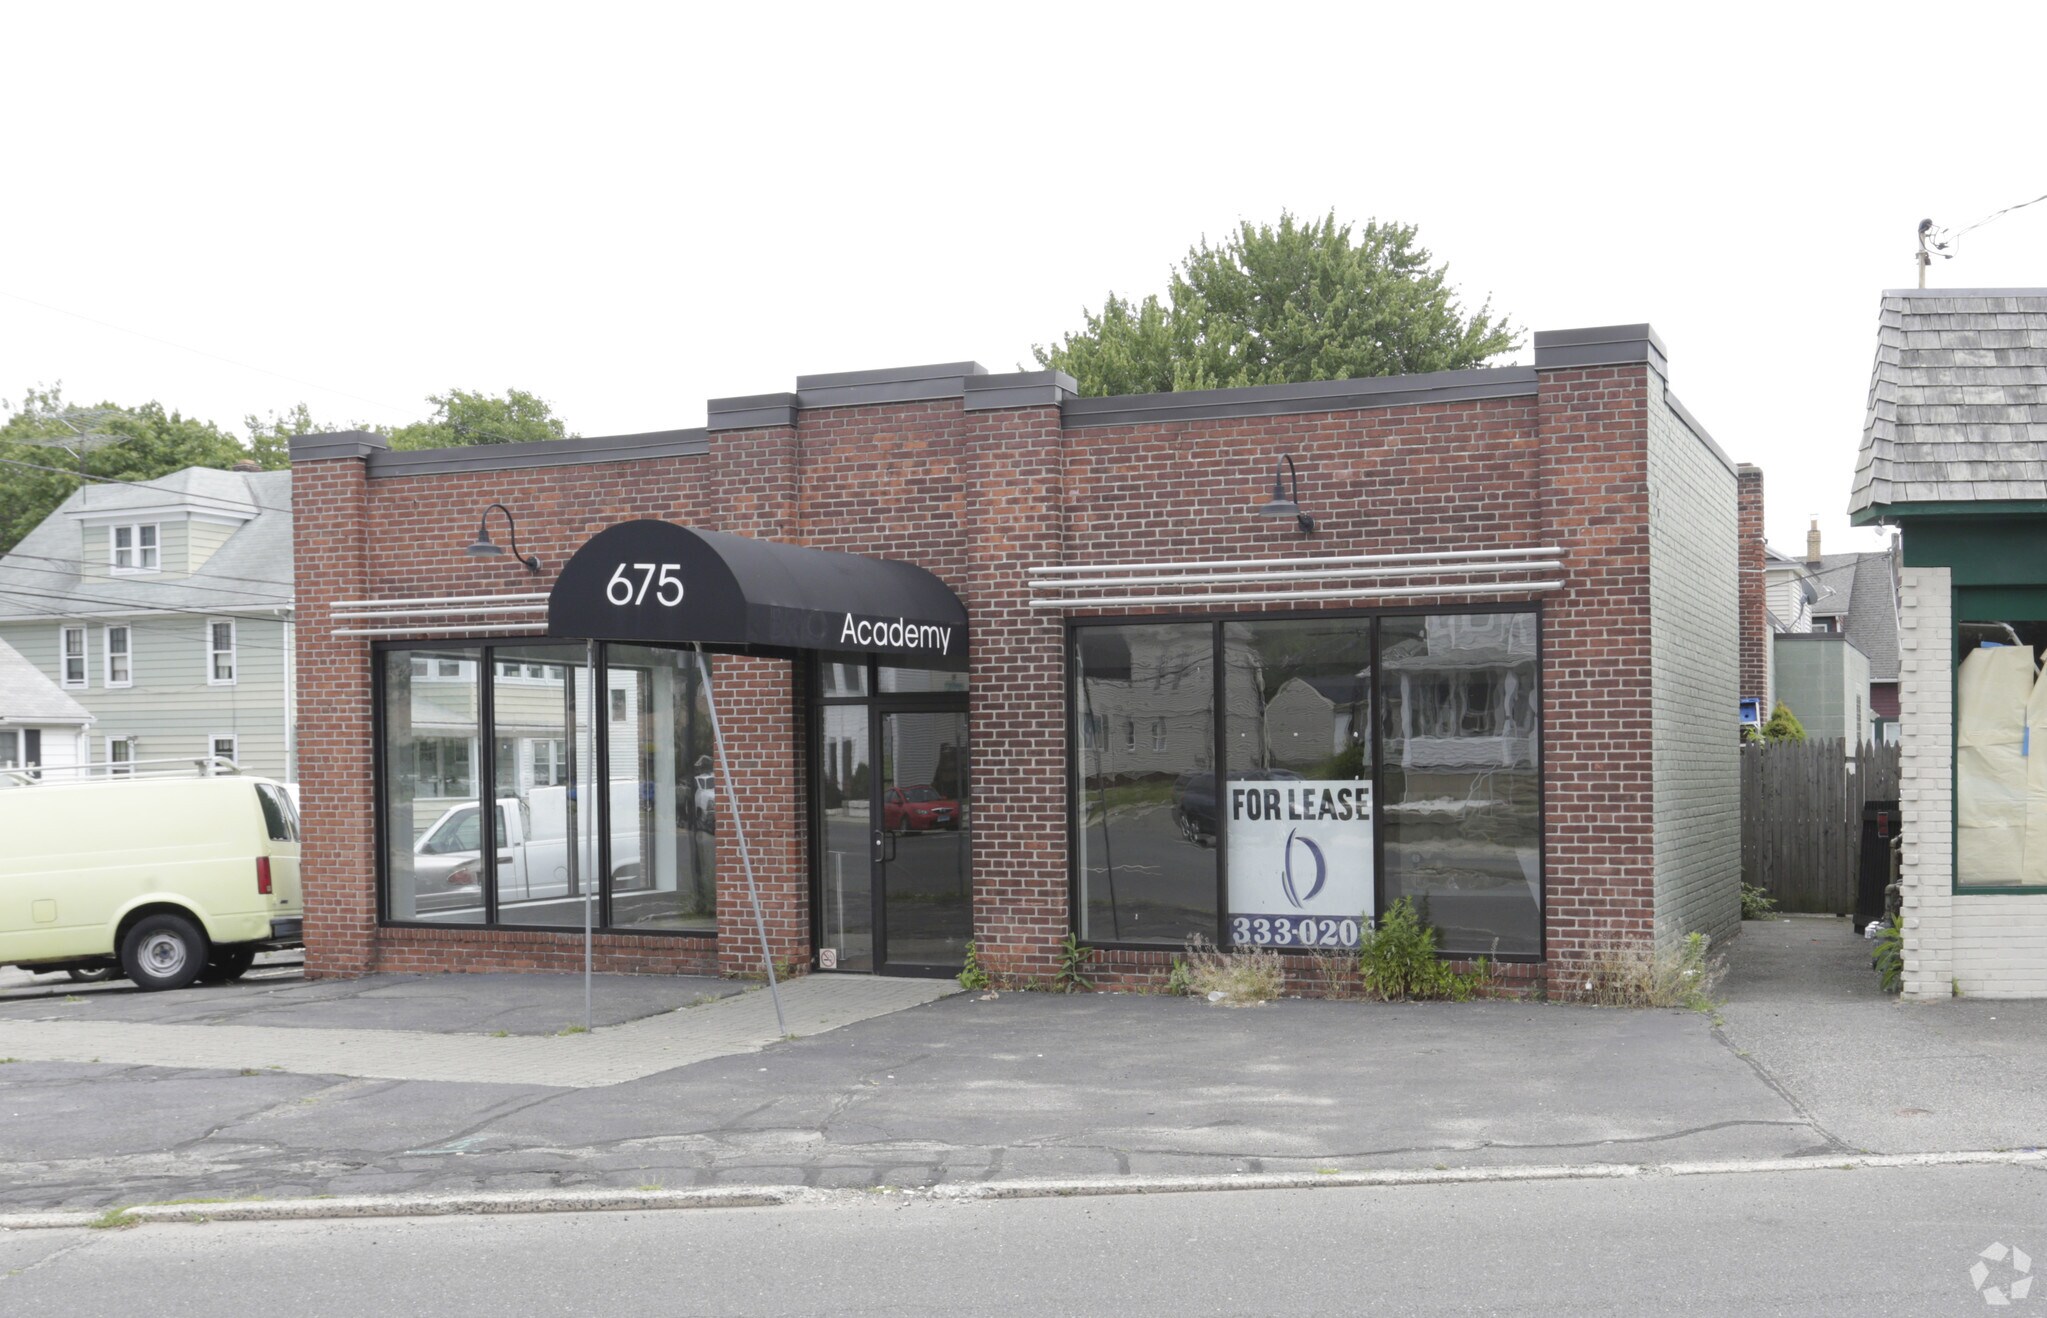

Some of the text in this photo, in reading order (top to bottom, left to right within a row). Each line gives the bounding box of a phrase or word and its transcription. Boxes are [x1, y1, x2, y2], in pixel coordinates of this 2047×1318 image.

[606, 563, 684, 607] 675
[841, 612, 951, 655] Academy
[1232, 787, 1370, 821] FOR LEASE
